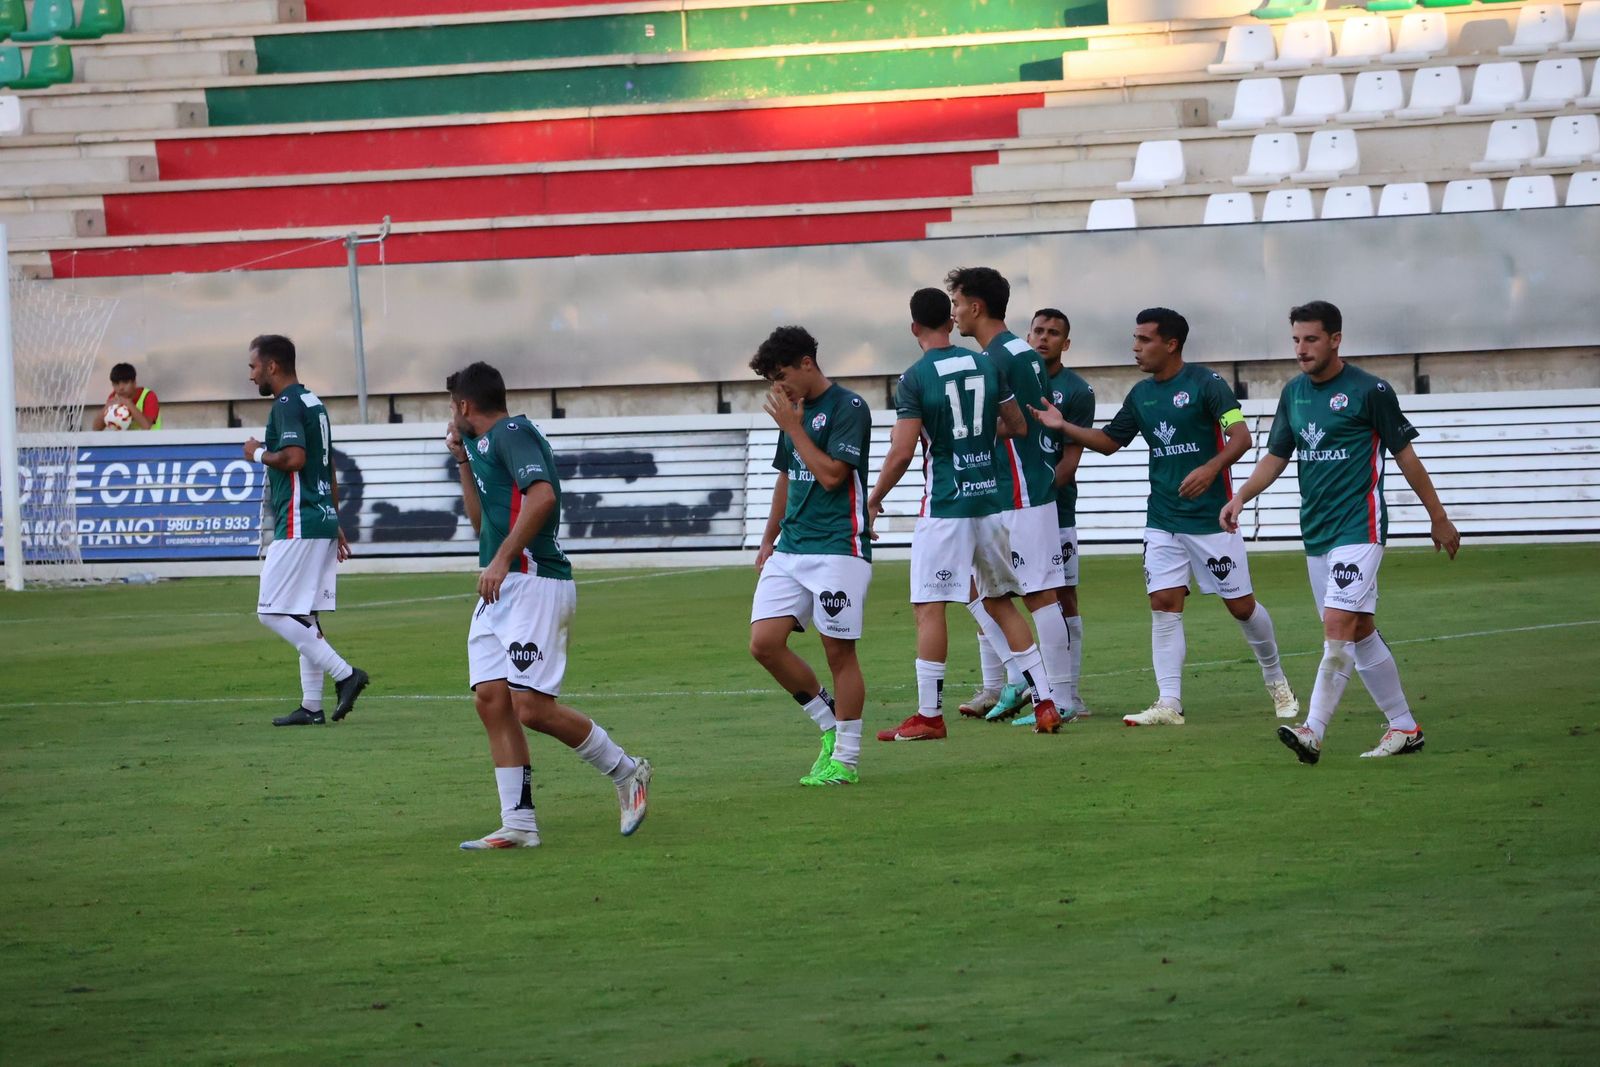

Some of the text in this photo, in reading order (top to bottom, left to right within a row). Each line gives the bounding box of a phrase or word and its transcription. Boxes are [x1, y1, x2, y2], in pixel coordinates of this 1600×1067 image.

[945, 375, 985, 440] 17
[1165, 442, 1200, 457] RURAL
[1309, 448, 1350, 461] RURAL
[14, 516, 250, 546] AMORANO 980 516 933
[506, 649, 544, 661] AMORA
